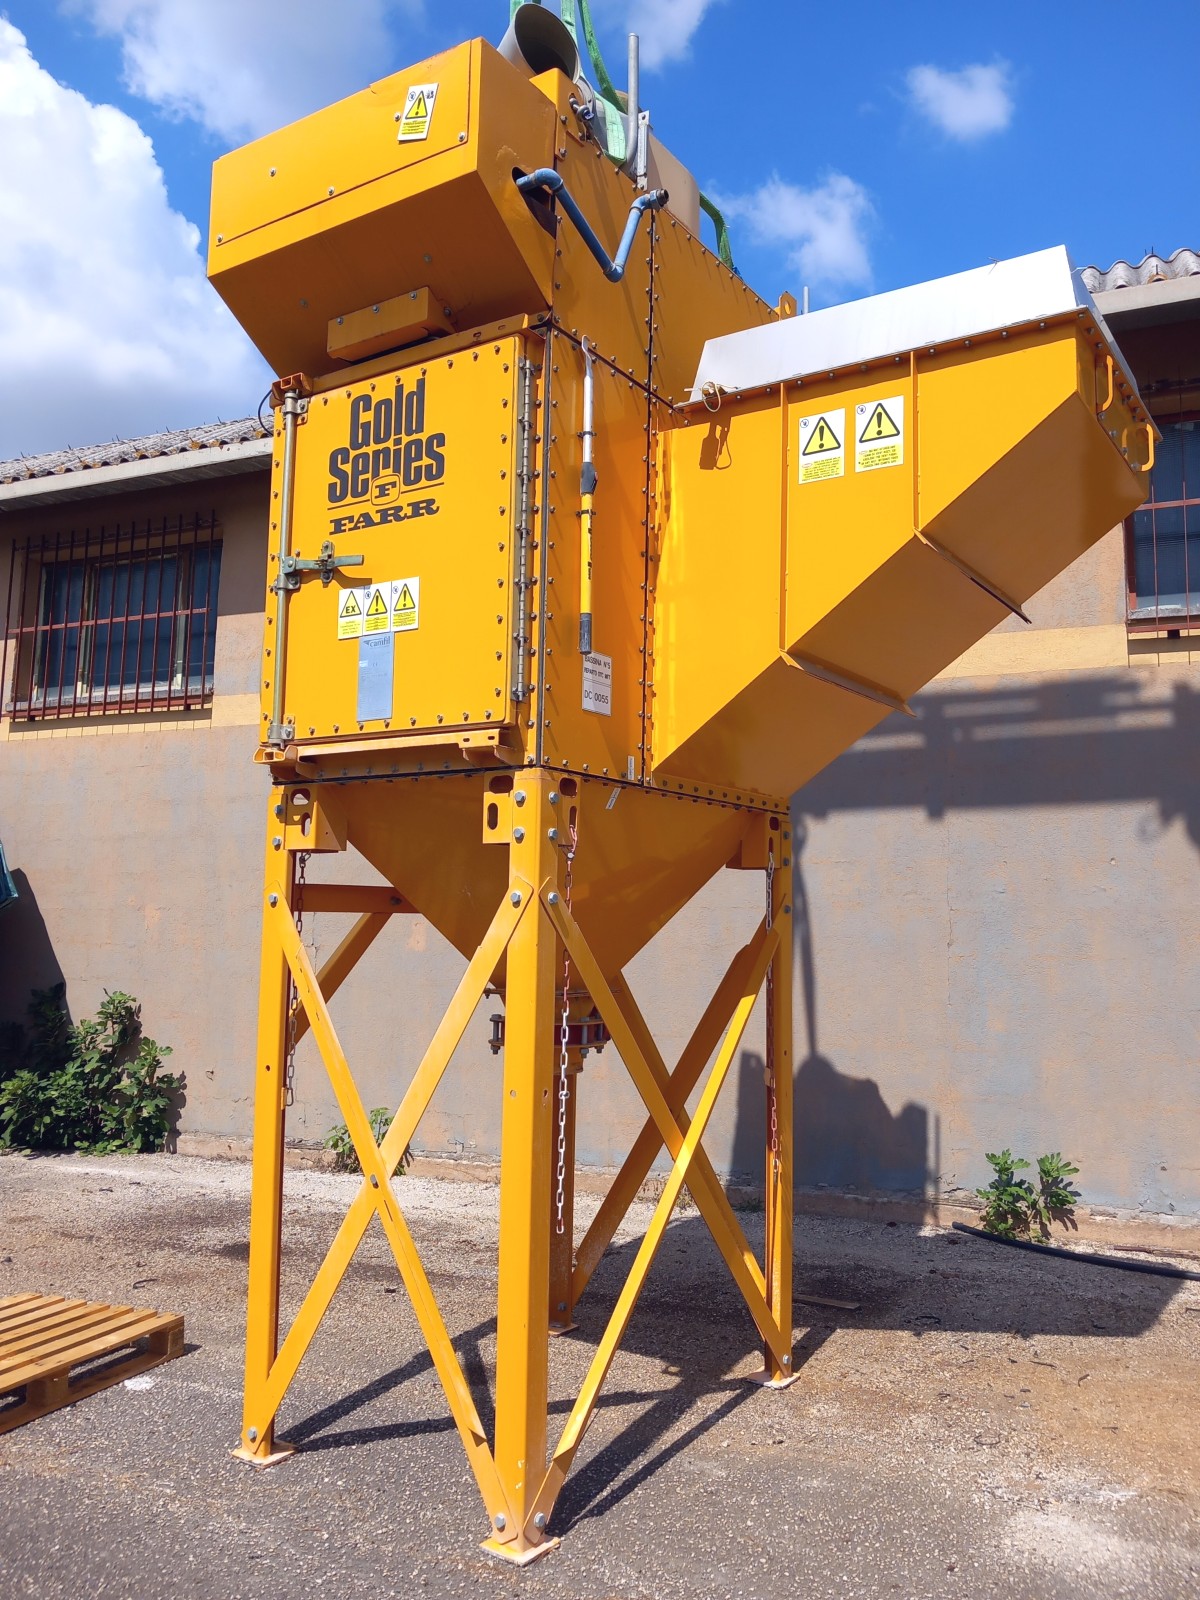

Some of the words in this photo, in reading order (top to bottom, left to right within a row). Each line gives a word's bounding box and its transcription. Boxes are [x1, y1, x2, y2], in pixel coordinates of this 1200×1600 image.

[349, 377, 426, 451] Gold
[327, 432, 446, 504] Series
[374, 481, 397, 499] F
[328, 498, 440, 536] FARR
[345, 605, 356, 614] EX
[369, 635, 391, 648] camfil
[584, 689, 593, 700] DC
[594, 692, 609, 705] 0055
